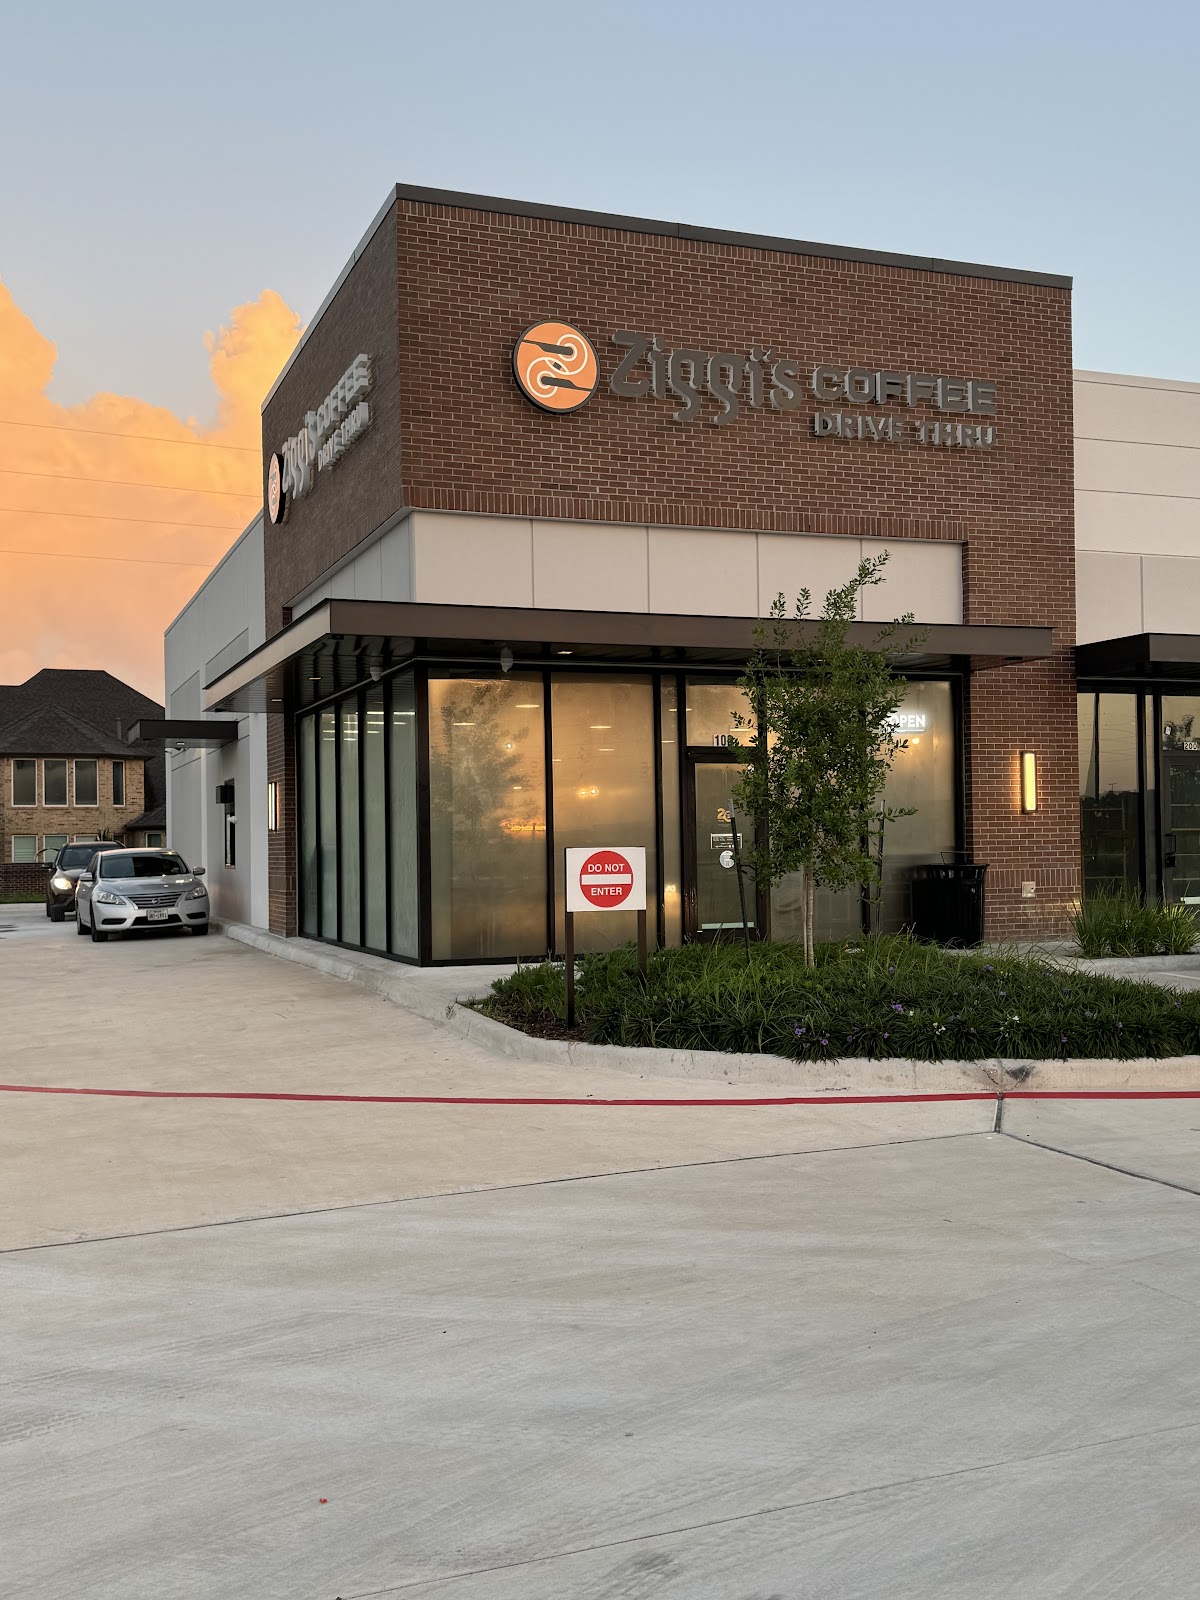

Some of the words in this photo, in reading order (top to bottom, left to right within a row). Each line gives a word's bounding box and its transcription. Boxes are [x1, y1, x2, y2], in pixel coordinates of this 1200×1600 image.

[611, 330, 802, 425] Ziggi's
[812, 365, 997, 413] COFFEE
[317, 353, 369, 437] COFFEE
[815, 411, 906, 443] DRIVE
[915, 419, 997, 449] THRU
[889, 714, 926, 728] OPEN
[587, 864, 603, 872] DO
[605, 863, 625, 872] NOT
[591, 887, 622, 896] ENTER
